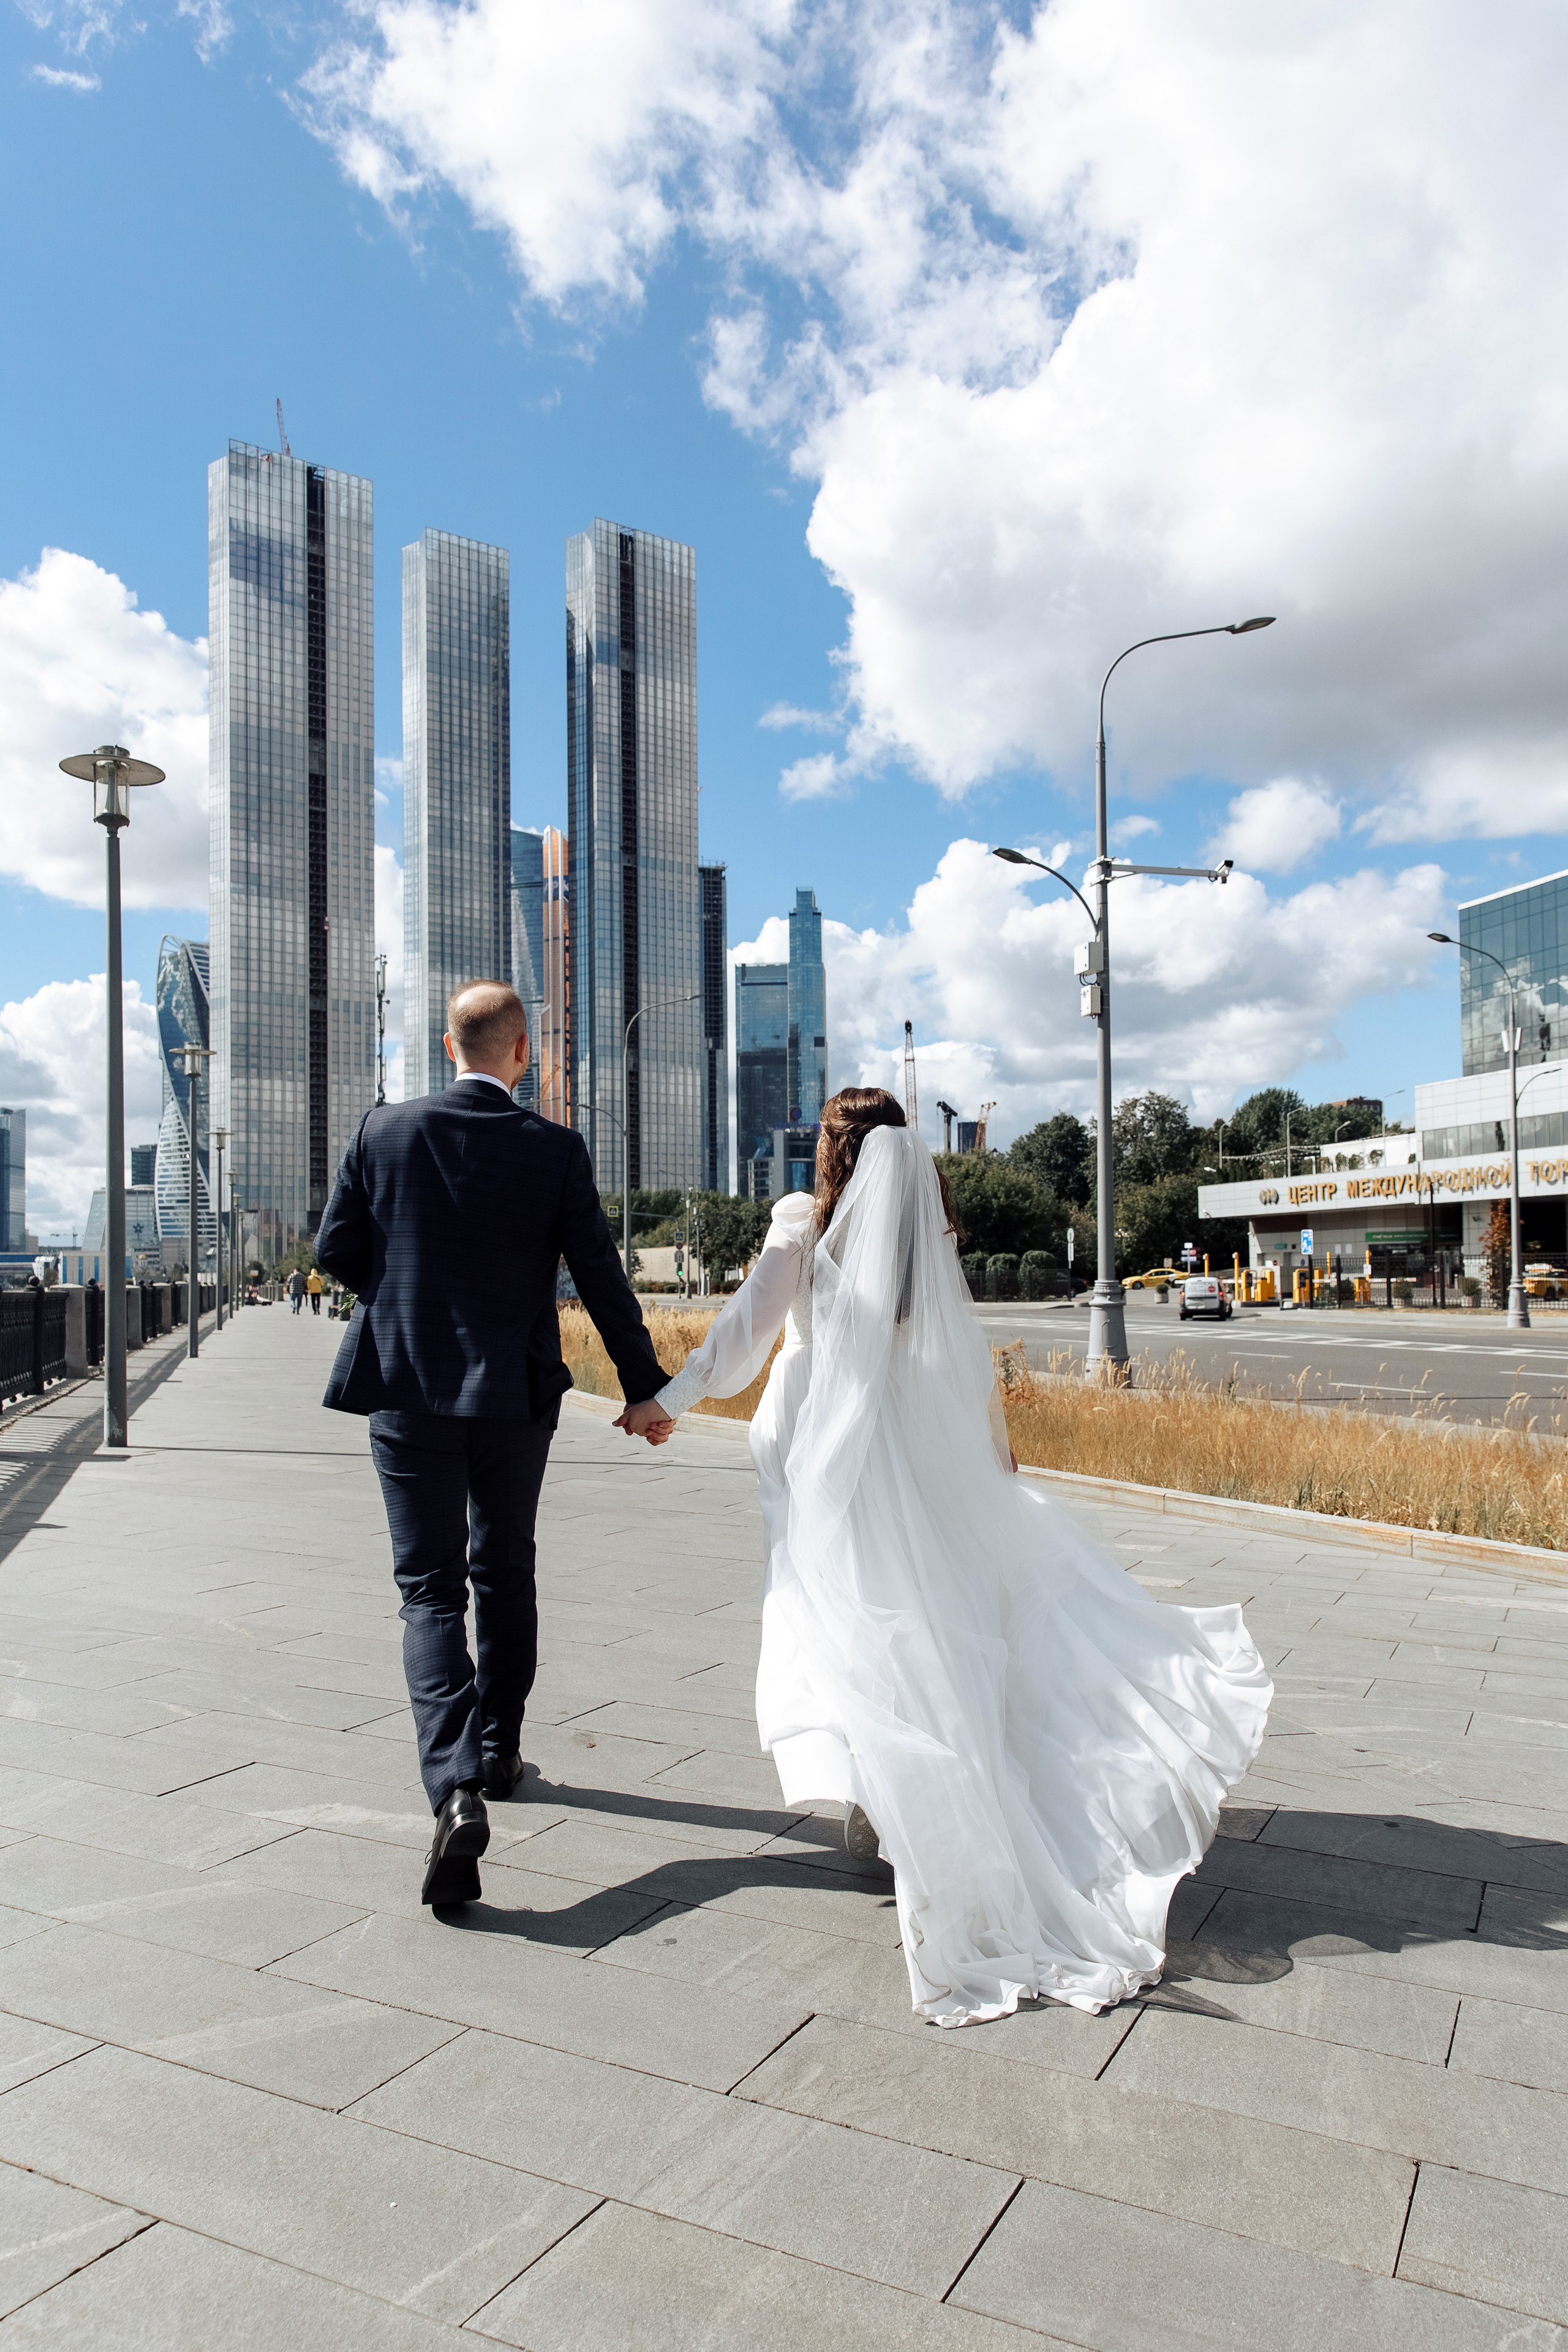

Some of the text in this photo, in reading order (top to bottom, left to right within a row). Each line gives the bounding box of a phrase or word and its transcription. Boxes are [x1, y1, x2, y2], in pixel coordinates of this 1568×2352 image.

[1288, 1158, 1568, 1206] ЦЕНТР МЕЖДУНАРОДНОЙ ТОР
